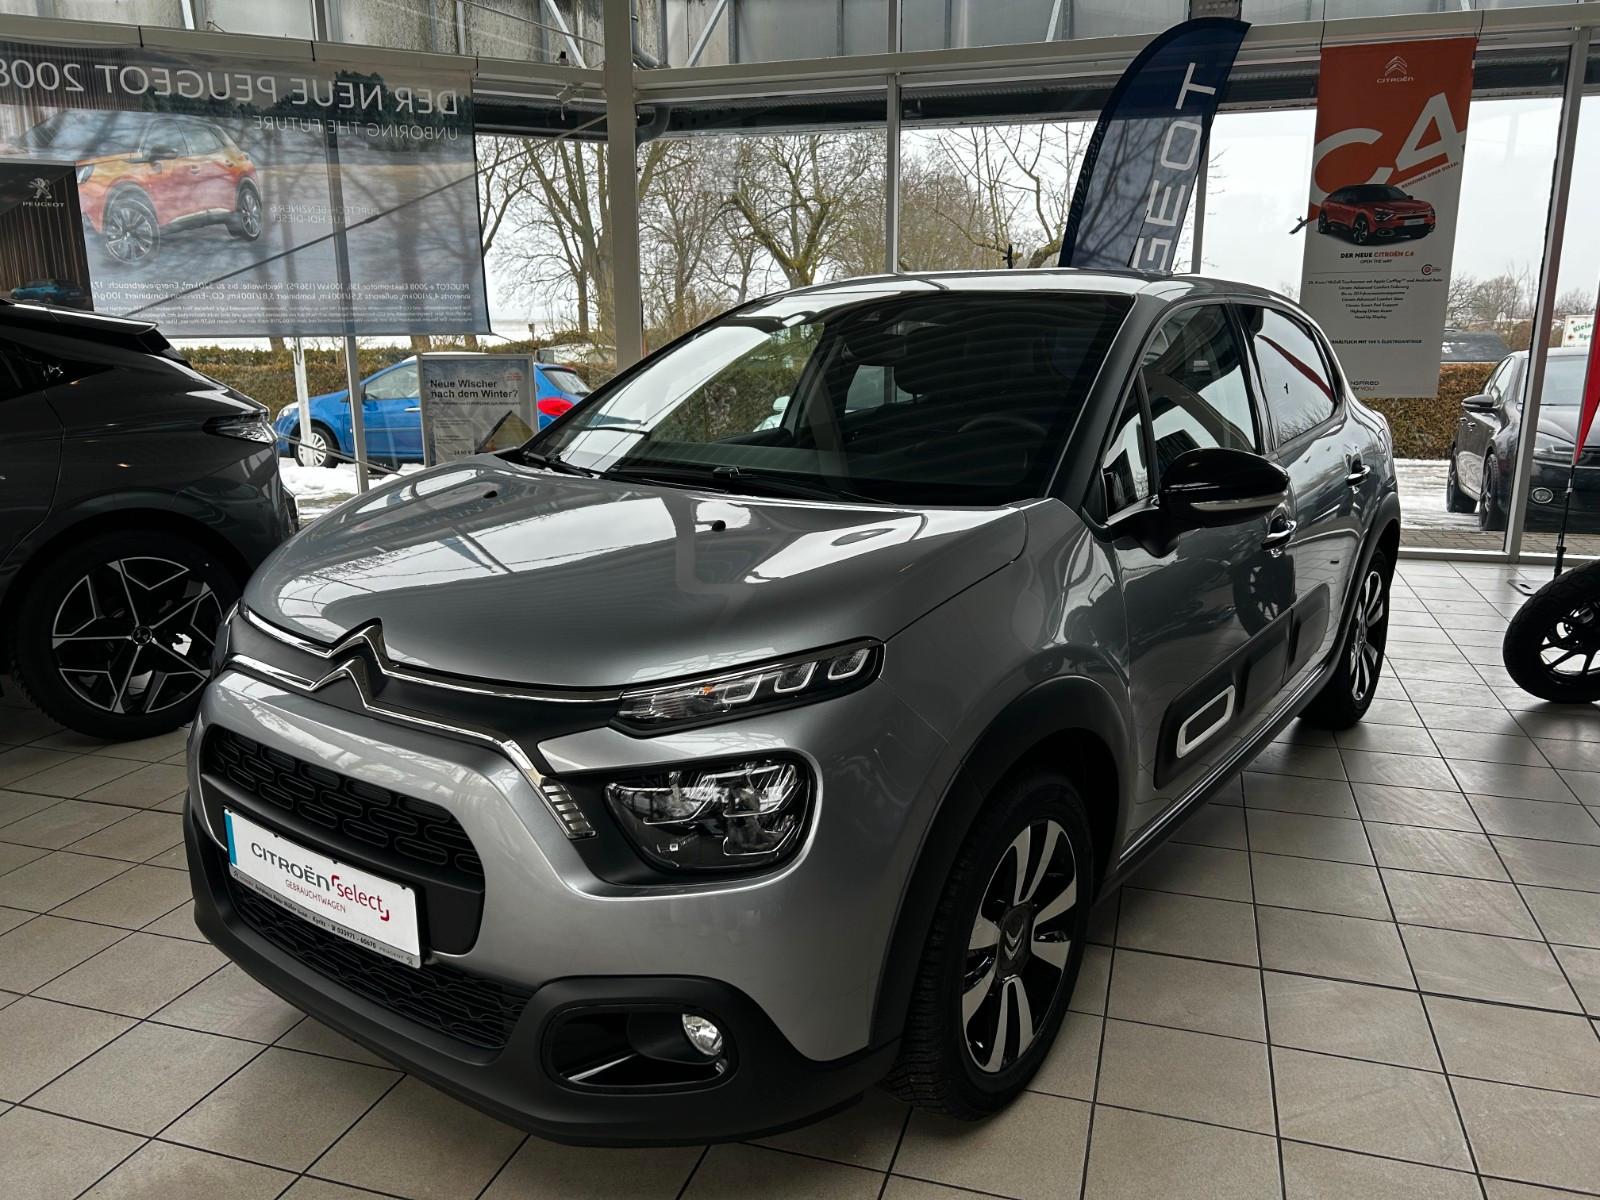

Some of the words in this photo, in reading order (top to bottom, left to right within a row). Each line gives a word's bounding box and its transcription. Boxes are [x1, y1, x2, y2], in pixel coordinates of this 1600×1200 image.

[1309, 91, 1468, 208] C4
[1131, 62, 1217, 272] GEOT
[430, 379, 456, 389] Neue
[457, 379, 498, 389] Wischer
[431, 390, 455, 398] nach
[457, 390, 479, 398] dem
[480, 389, 519, 398] Winter?
[285, 879, 347, 913] GEBRAUCHTWAGEN
